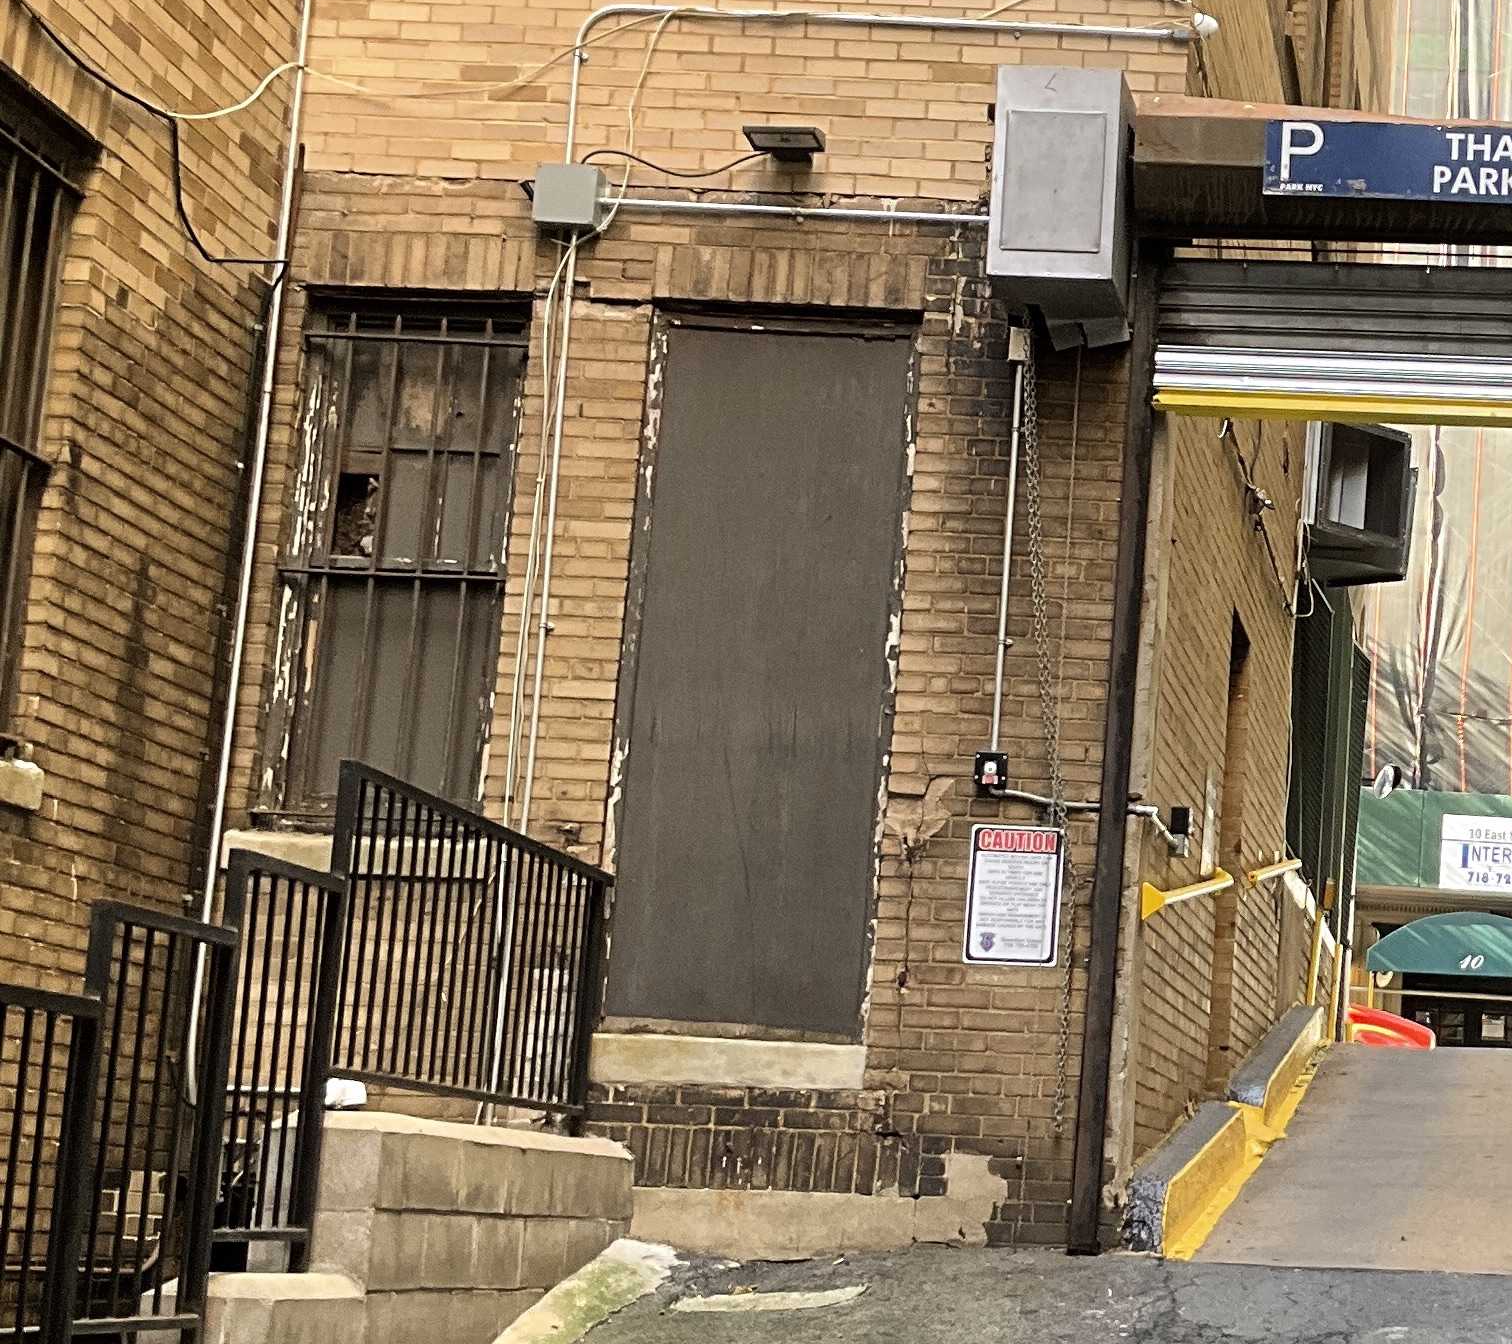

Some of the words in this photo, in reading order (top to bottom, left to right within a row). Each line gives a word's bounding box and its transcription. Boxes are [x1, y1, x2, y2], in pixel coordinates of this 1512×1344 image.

[1280, 122, 1324, 182] P
[1280, 183, 1304, 191] PARK
[1305, 184, 1324, 192] NYC
[1469, 828, 1482, 839] 10
[1485, 829, 1507, 838] East
[979, 830, 1057, 852] CAUTION
[1459, 955, 1484, 969] 10
